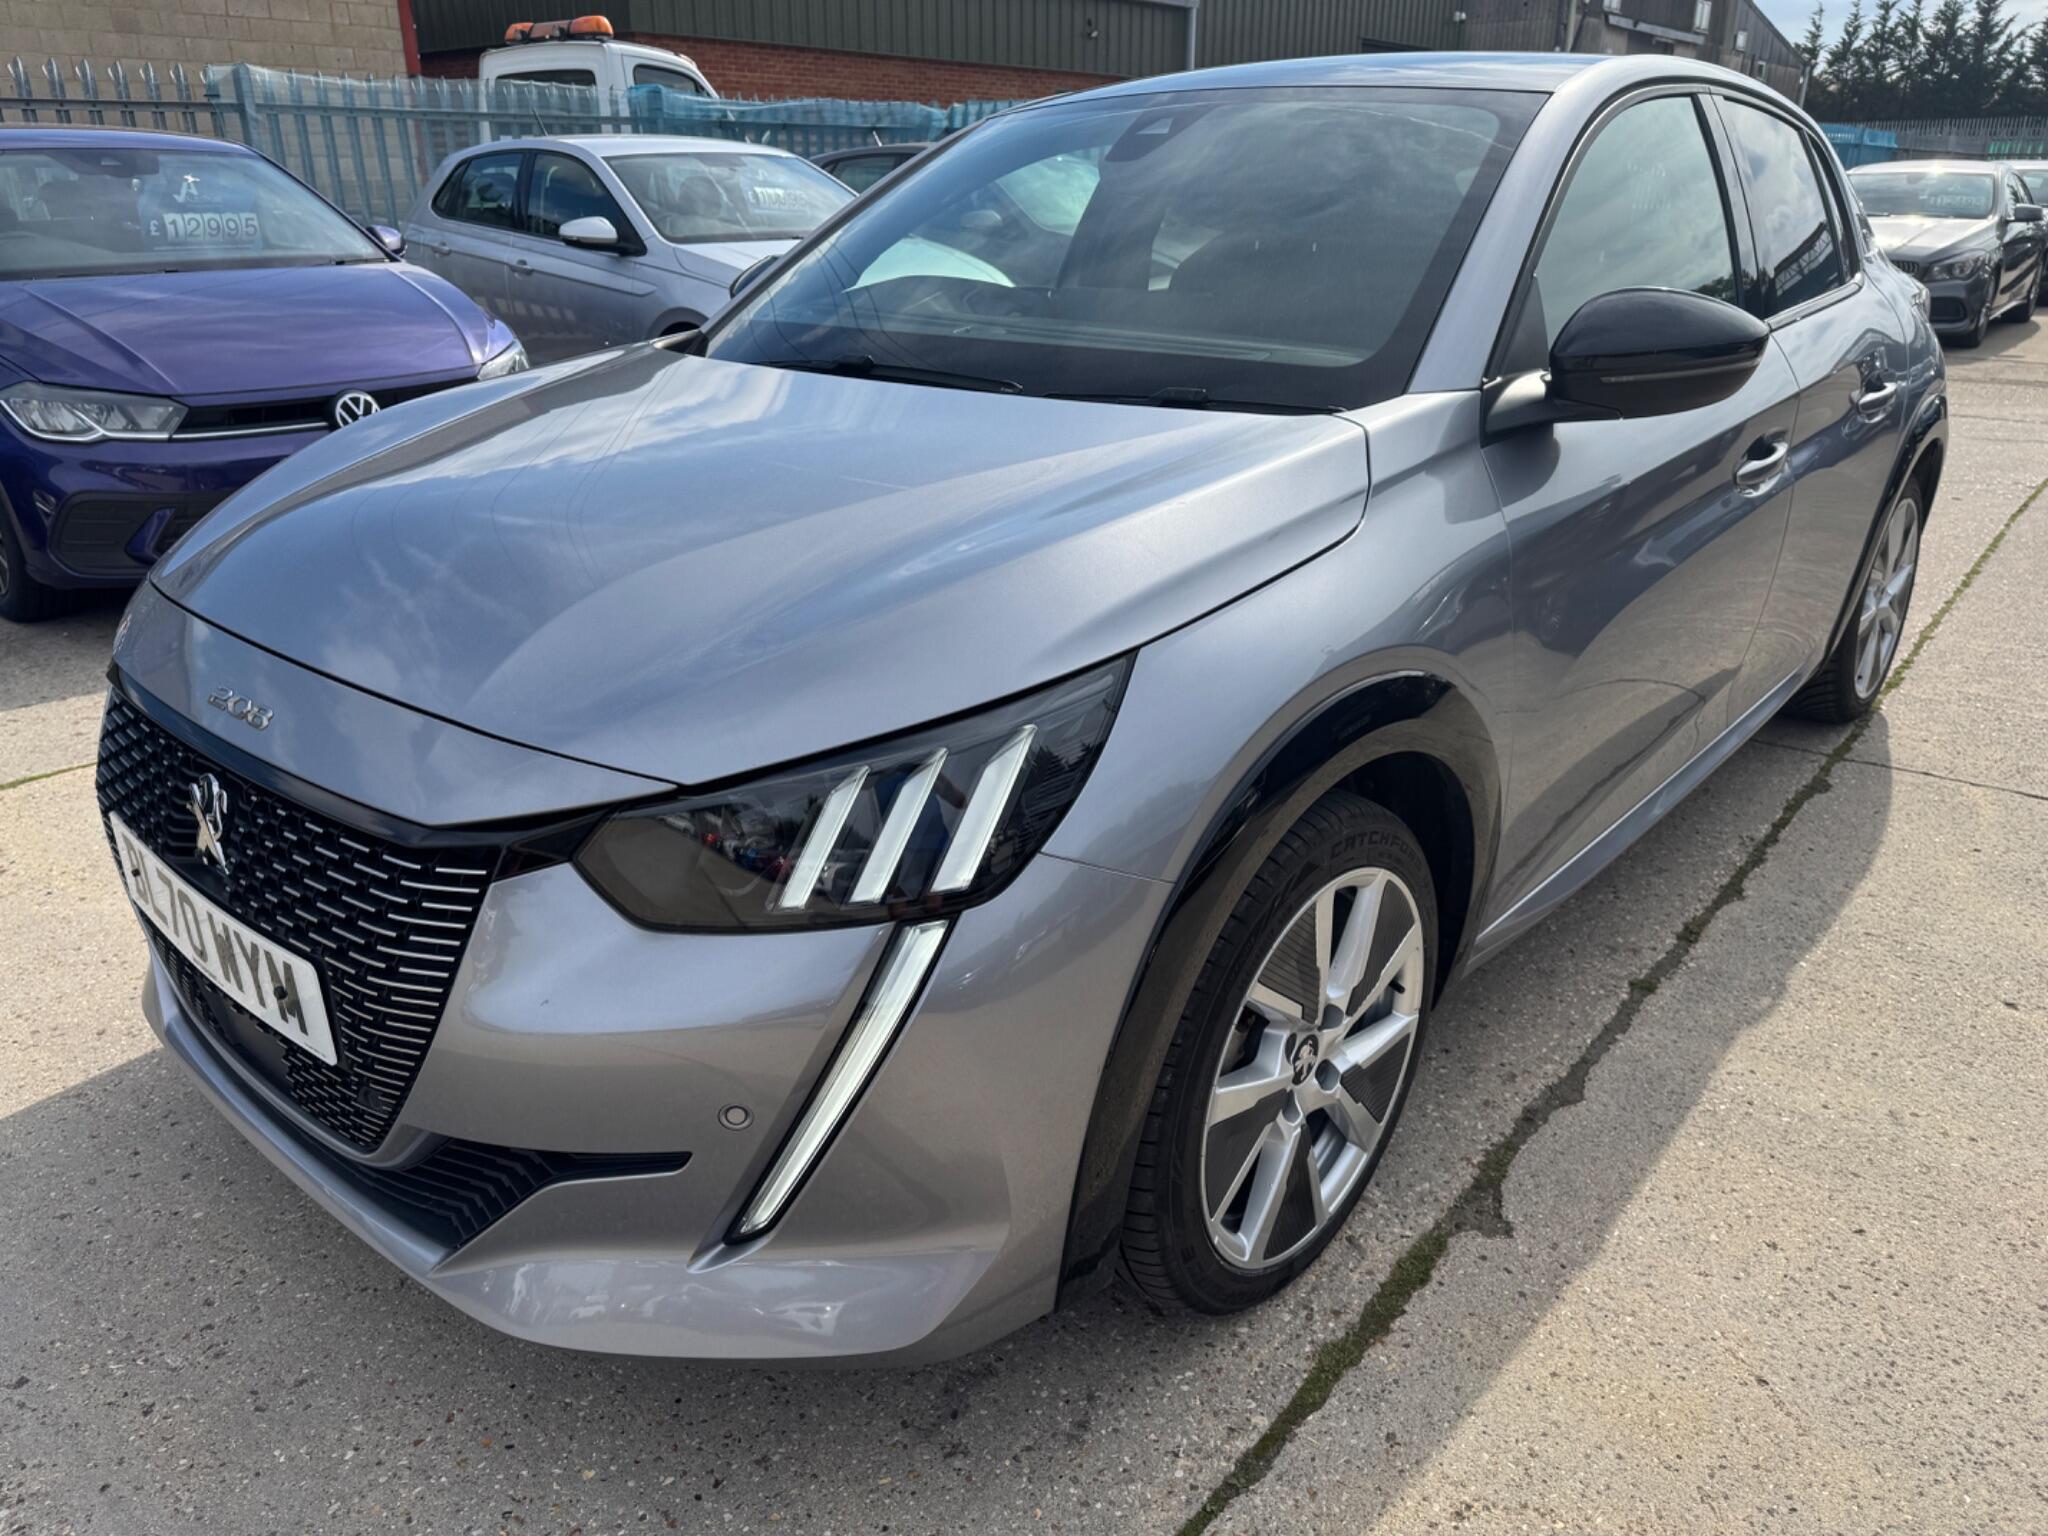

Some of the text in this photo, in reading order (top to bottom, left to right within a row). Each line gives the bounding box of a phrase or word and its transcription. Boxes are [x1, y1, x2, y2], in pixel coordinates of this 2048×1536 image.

[208, 687, 273, 731] 208
[121, 831, 308, 1036] BL70 WYM
